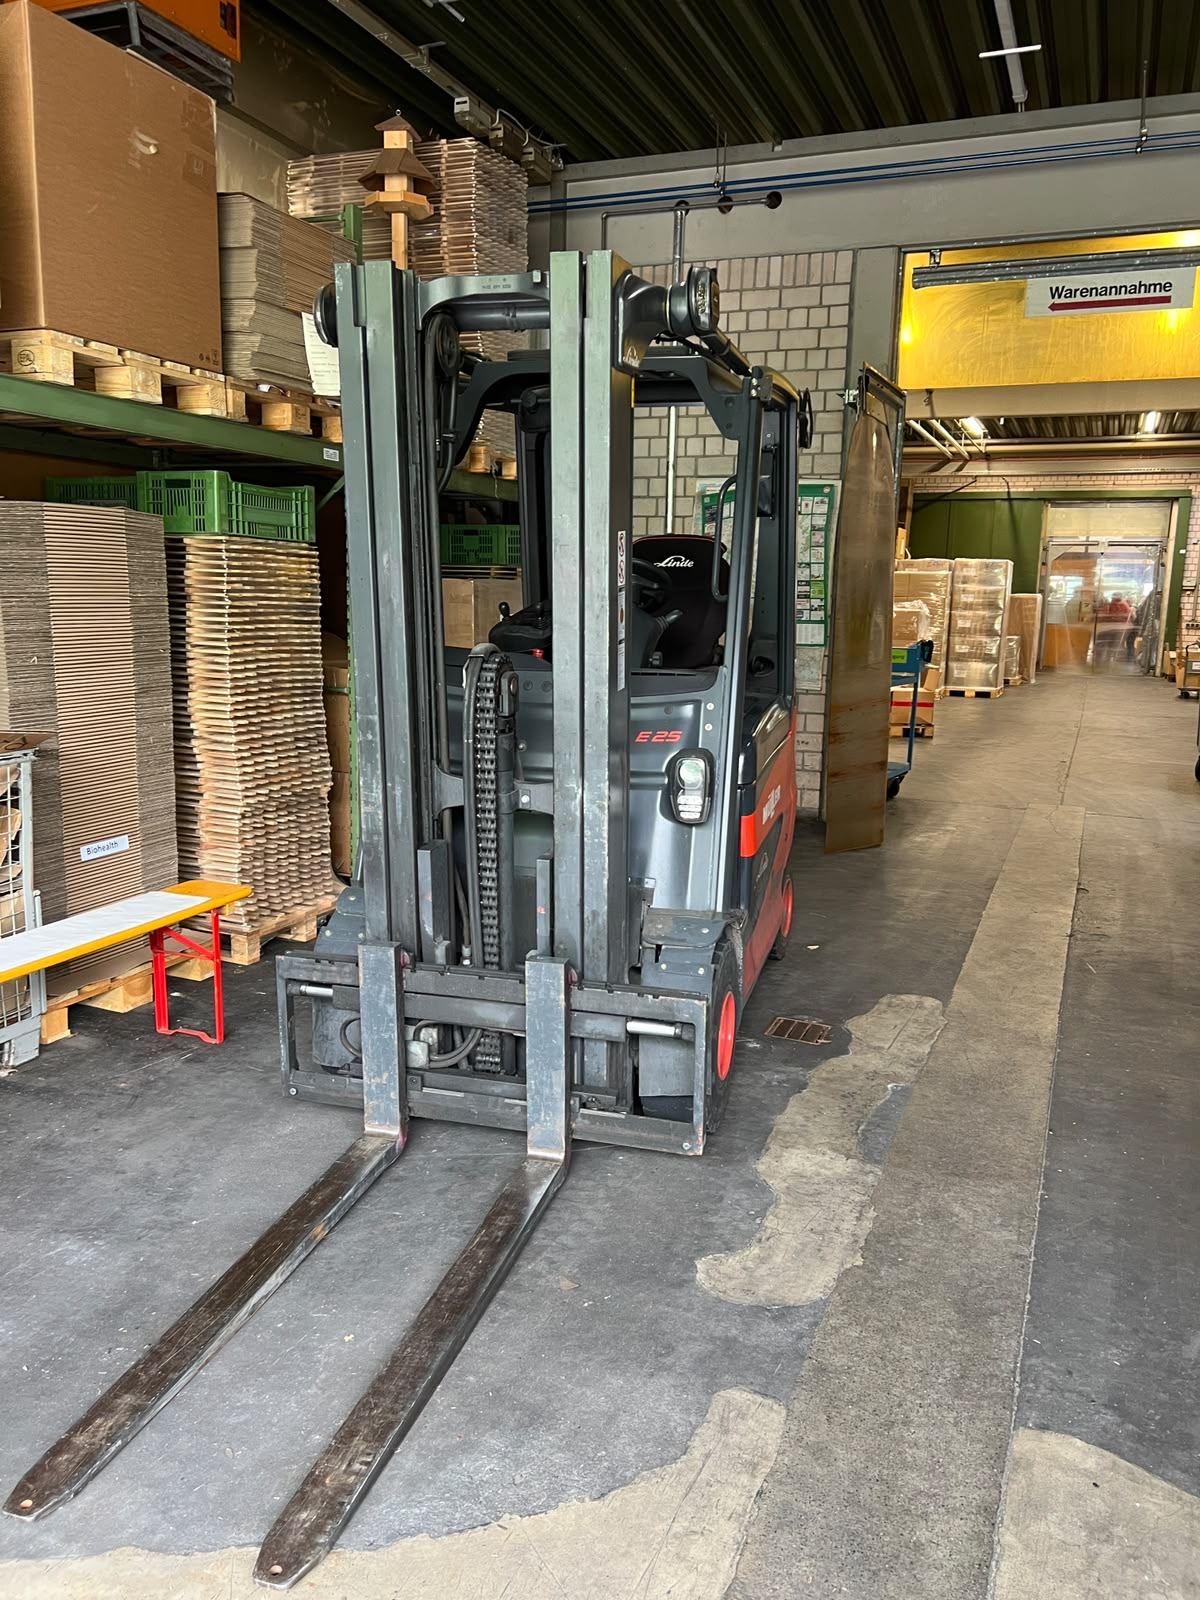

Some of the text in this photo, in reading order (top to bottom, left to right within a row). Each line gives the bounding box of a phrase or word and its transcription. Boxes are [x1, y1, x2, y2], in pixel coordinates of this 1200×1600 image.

[1050, 281, 1172, 299] Warenannahme
[653, 555, 694, 567] Linde
[87, 841, 119, 855] Biohealth
